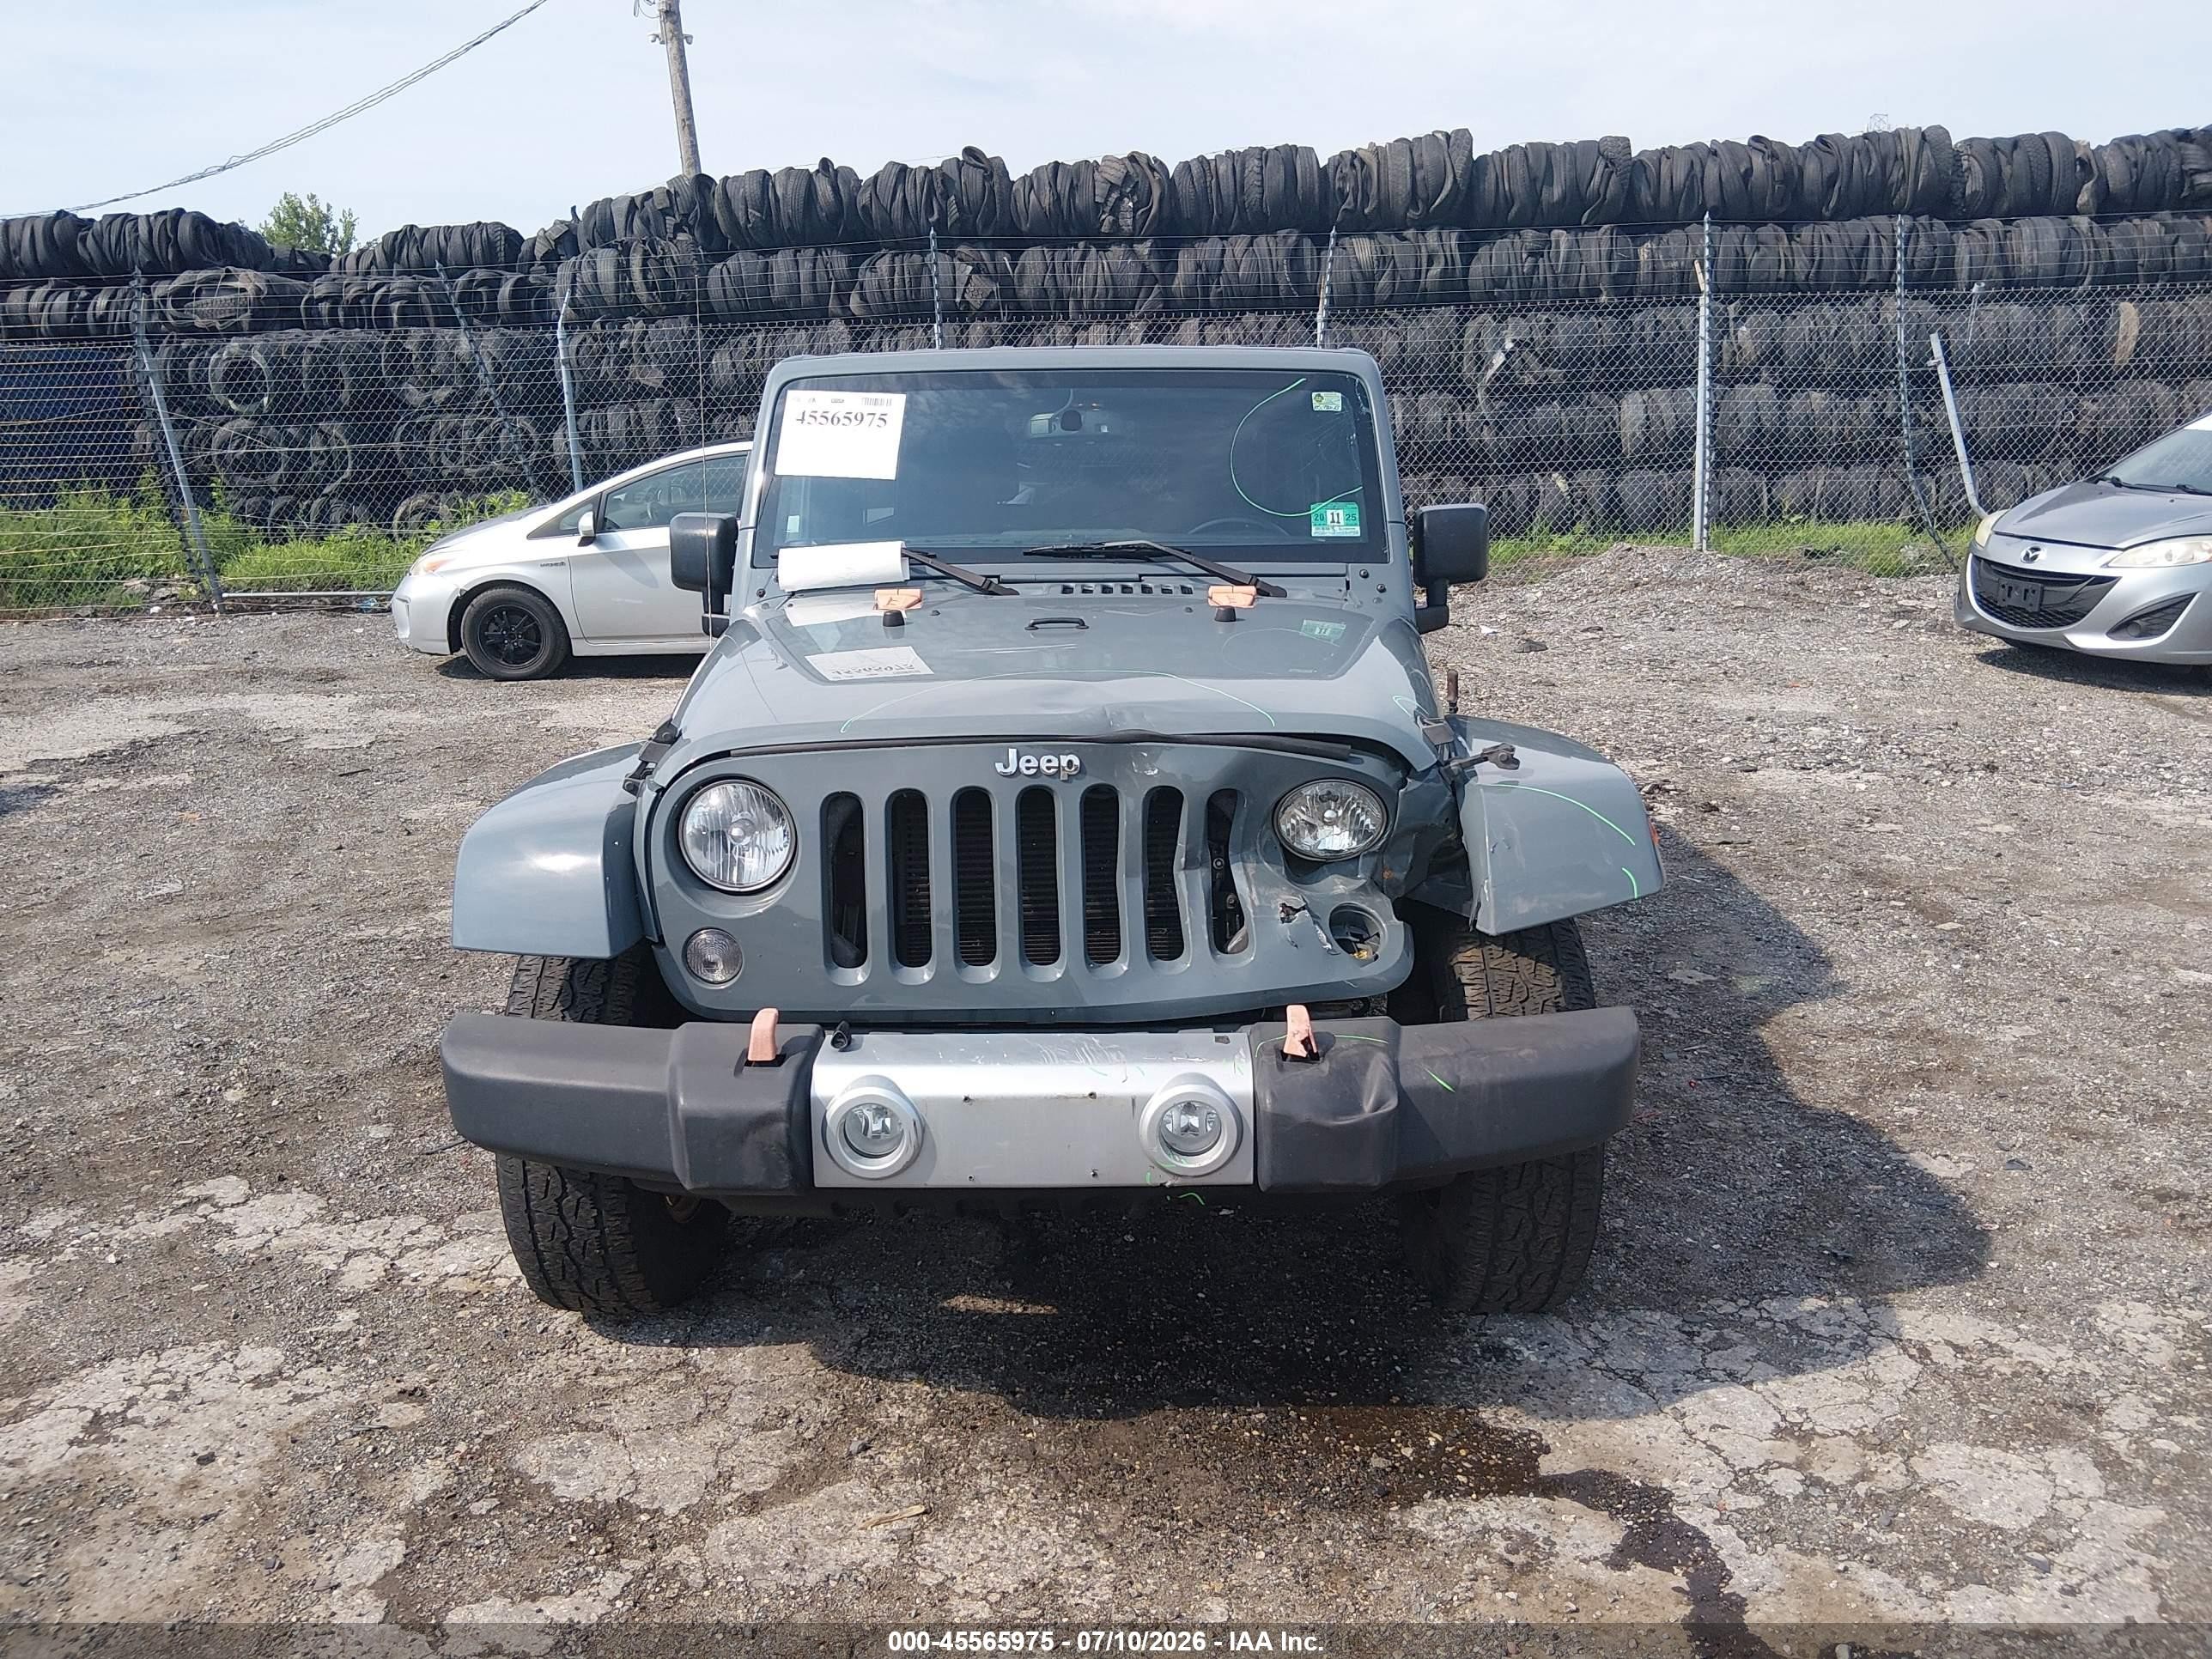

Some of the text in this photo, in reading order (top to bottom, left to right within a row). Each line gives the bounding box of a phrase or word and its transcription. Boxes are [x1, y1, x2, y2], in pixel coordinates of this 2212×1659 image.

[796, 410, 889, 428] 45565975
[1314, 513, 1325, 521] 20
[1329, 511, 1341, 525] 11
[994, 748, 1080, 781] Jeep
